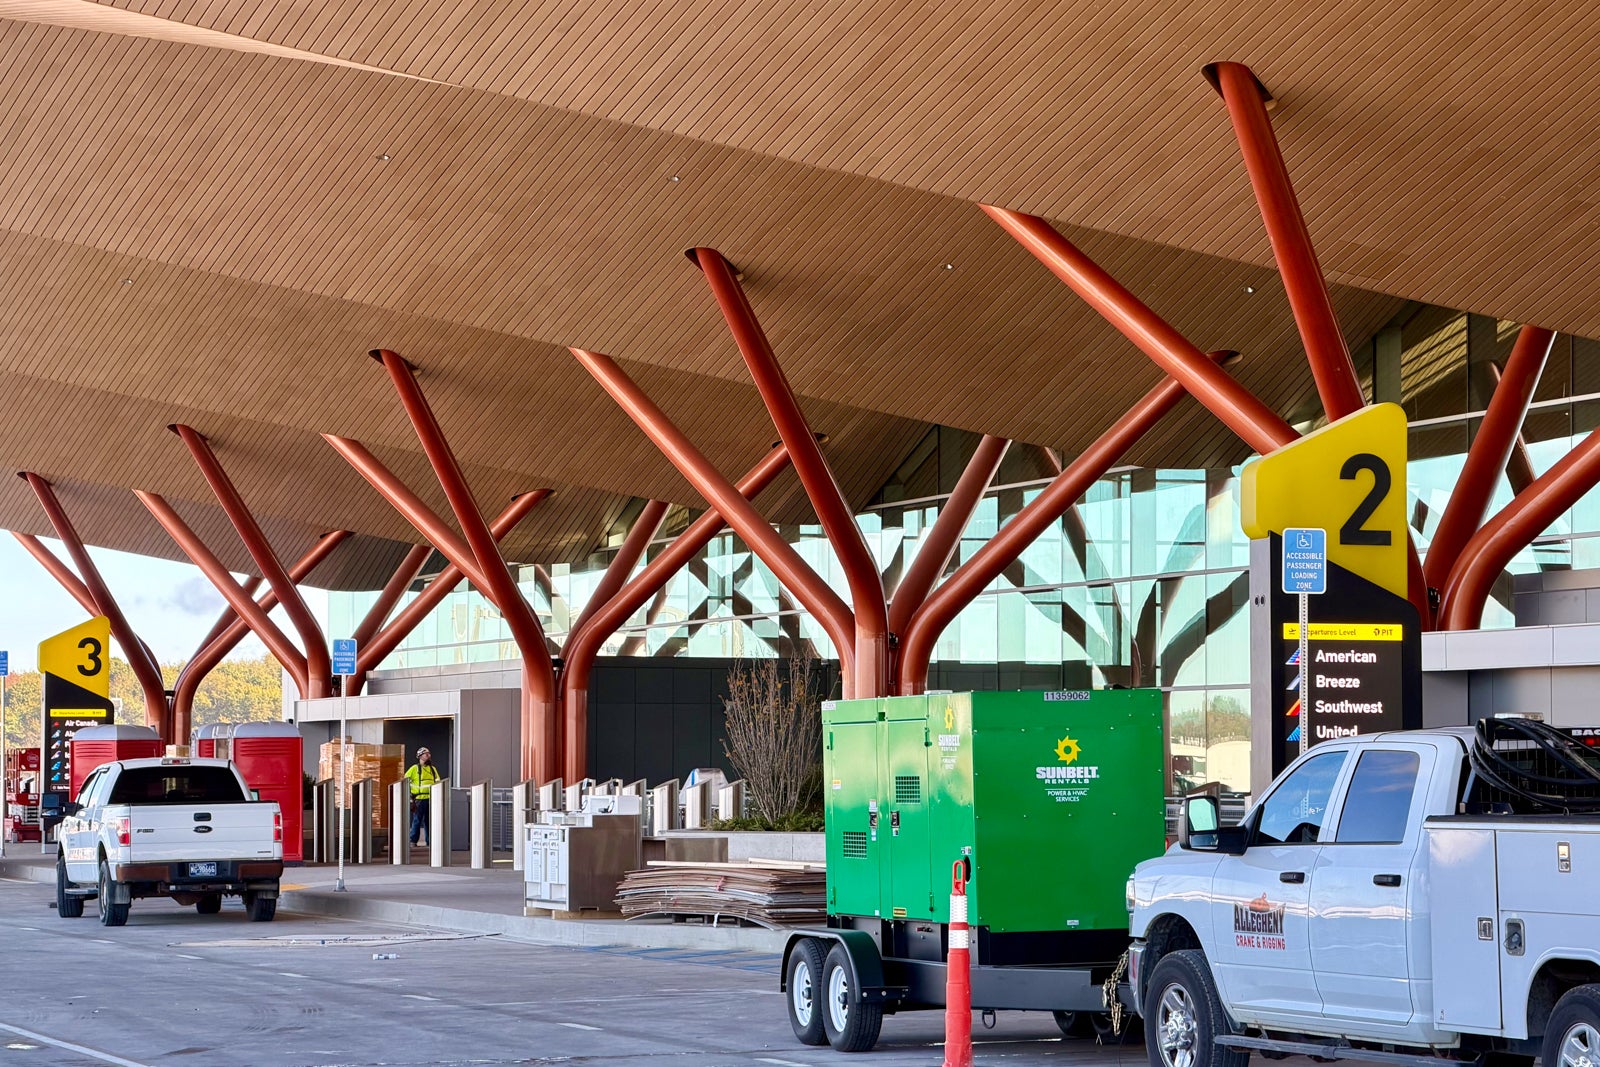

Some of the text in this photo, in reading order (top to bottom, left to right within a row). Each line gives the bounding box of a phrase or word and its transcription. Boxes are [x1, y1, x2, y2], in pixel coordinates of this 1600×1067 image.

[1339, 453, 1392, 546] 2
[1286, 552, 1323, 560] ACCESSIBLE
[1286, 562, 1323, 570] PASSENGER
[1307, 628, 1357, 637] partures Level
[77, 636, 102, 677] 3
[1315, 649, 1377, 663] American
[1316, 674, 1361, 688] Breeze
[1044, 691, 1089, 700] 11359062
[1315, 699, 1383, 714] Southwest
[64, 719, 75, 727] Air
[1316, 725, 1358, 739] United
[1035, 766, 1099, 779] SUNBELT
[1234, 902, 1286, 934] ALLEGHENY
[1235, 934, 1286, 951] CRANE & RIGGING
